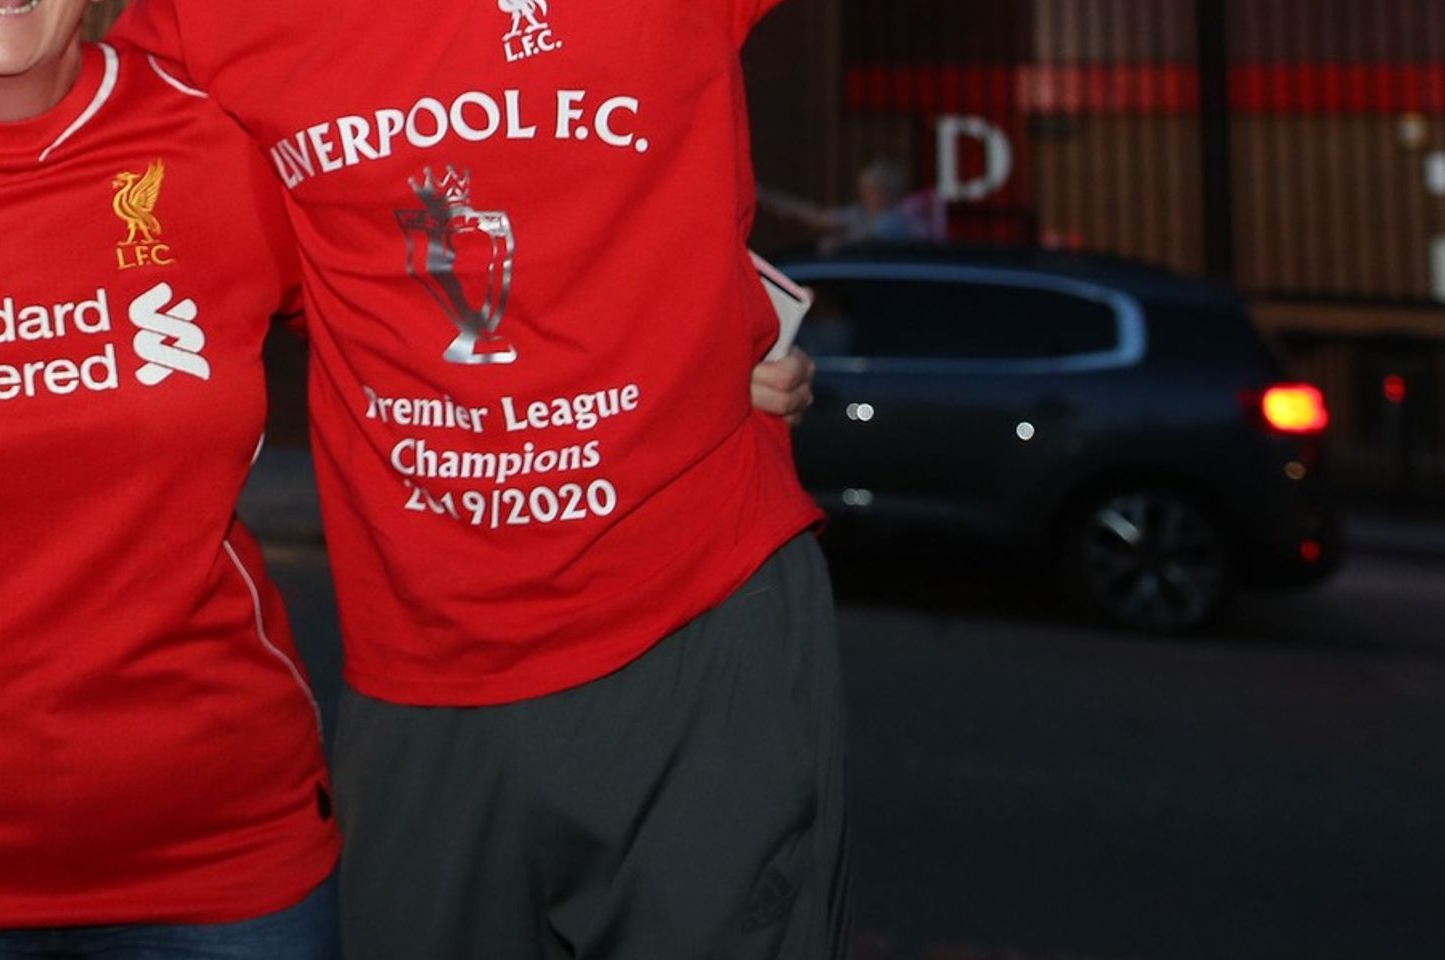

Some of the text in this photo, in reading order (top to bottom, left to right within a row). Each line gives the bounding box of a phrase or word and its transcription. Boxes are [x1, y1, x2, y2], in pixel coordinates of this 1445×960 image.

[503, 29, 563, 62] L.F.C.
[270, 89, 649, 190] LIVERPOOL F.C.
[934, 114, 1013, 202] D
[364, 384, 640, 433] Premier League
[390, 437, 601, 484] Champions
